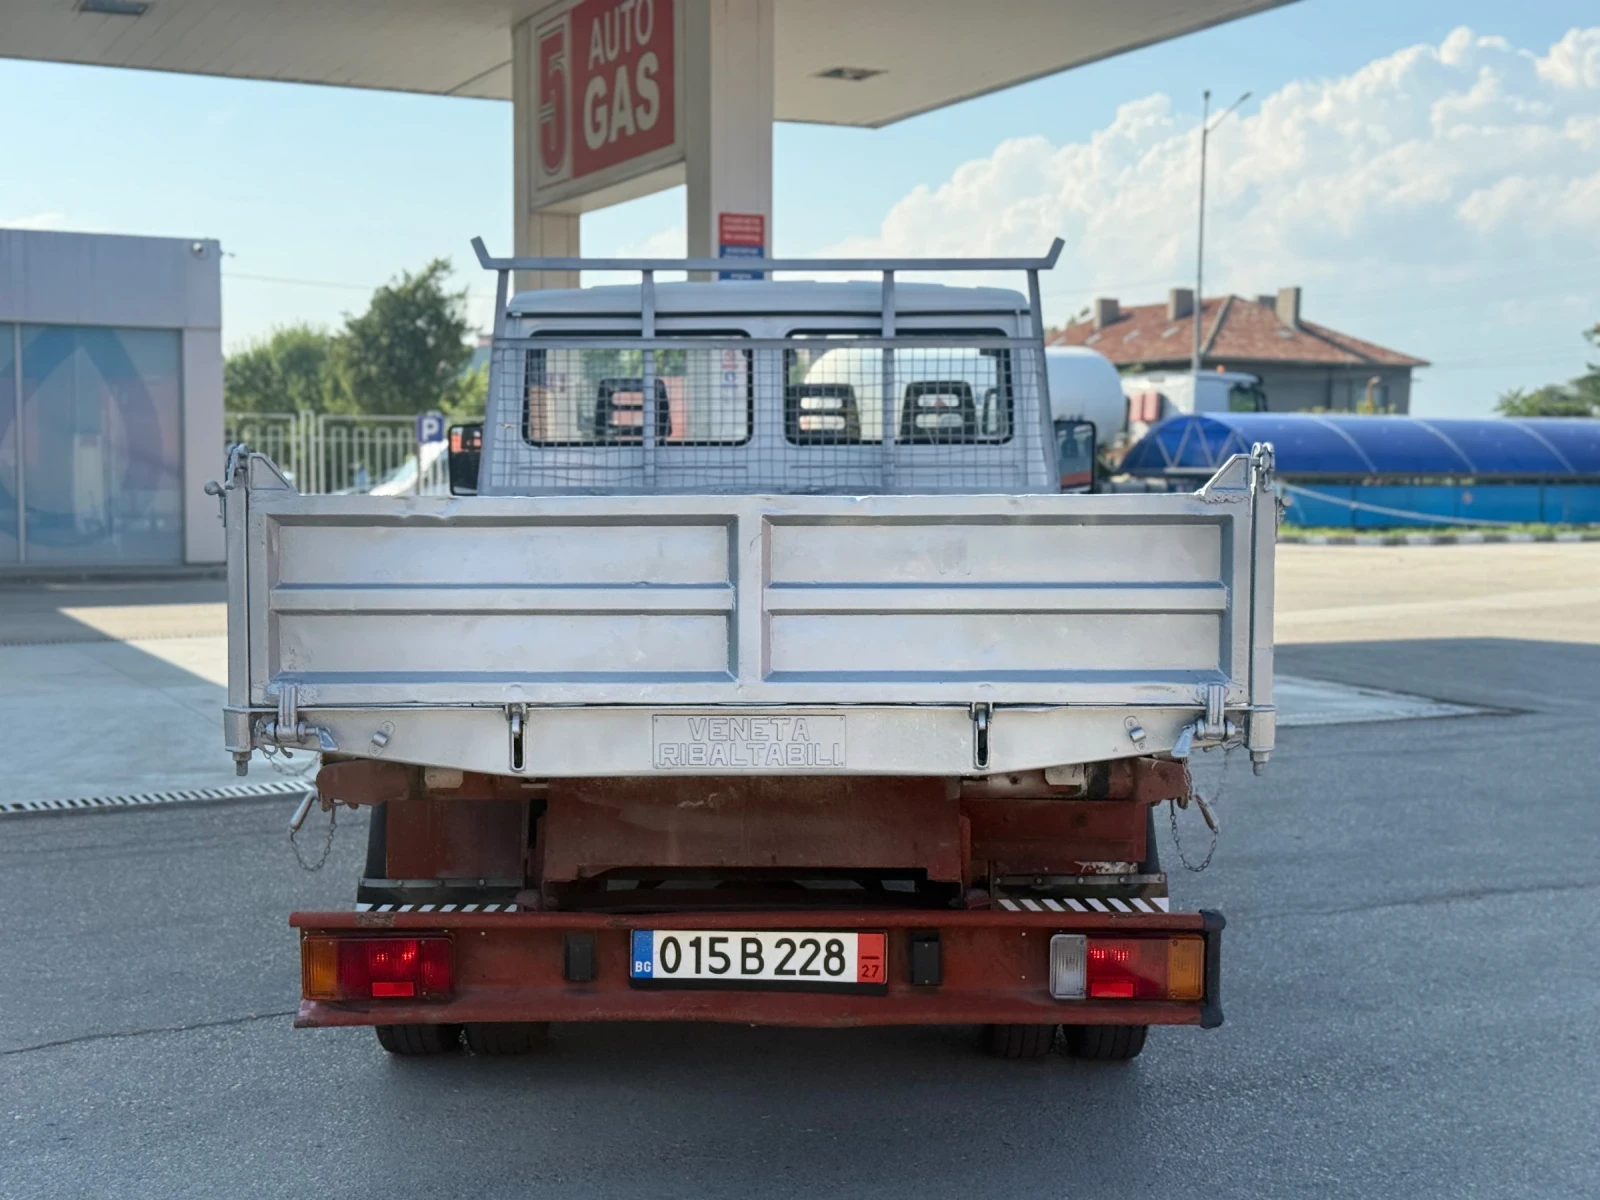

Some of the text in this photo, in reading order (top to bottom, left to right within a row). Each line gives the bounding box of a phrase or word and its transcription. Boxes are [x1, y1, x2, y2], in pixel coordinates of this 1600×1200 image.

[587, 0, 654, 71] AUTO
[583, 52, 661, 150] GAS
[422, 419, 439, 441] P
[688, 718, 811, 741] VENETA
[658, 743, 840, 766] RIBALTABILI
[635, 961, 652, 973] BG
[861, 965, 879, 978] 27
